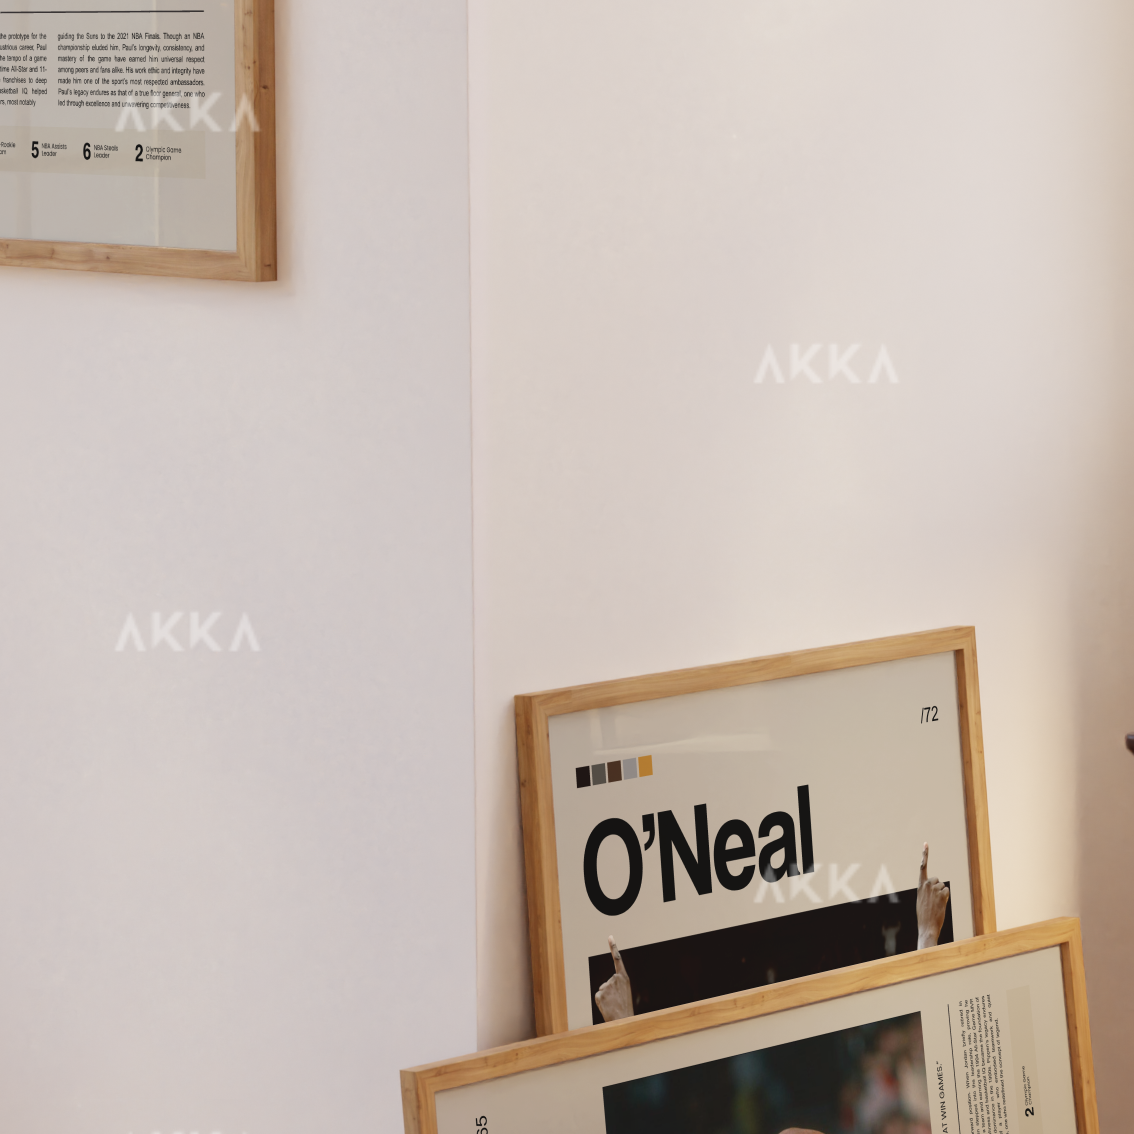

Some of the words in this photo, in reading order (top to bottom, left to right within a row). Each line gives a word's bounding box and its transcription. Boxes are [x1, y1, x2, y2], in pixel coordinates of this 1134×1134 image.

[31, 141, 39, 158] 5
[83, 142, 91, 160] 6
[135, 144, 144, 162] 2
[921, 706, 939, 724] /72
[583, 785, 814, 917] O'Neal
[1025, 1107, 1035, 1117] 2
